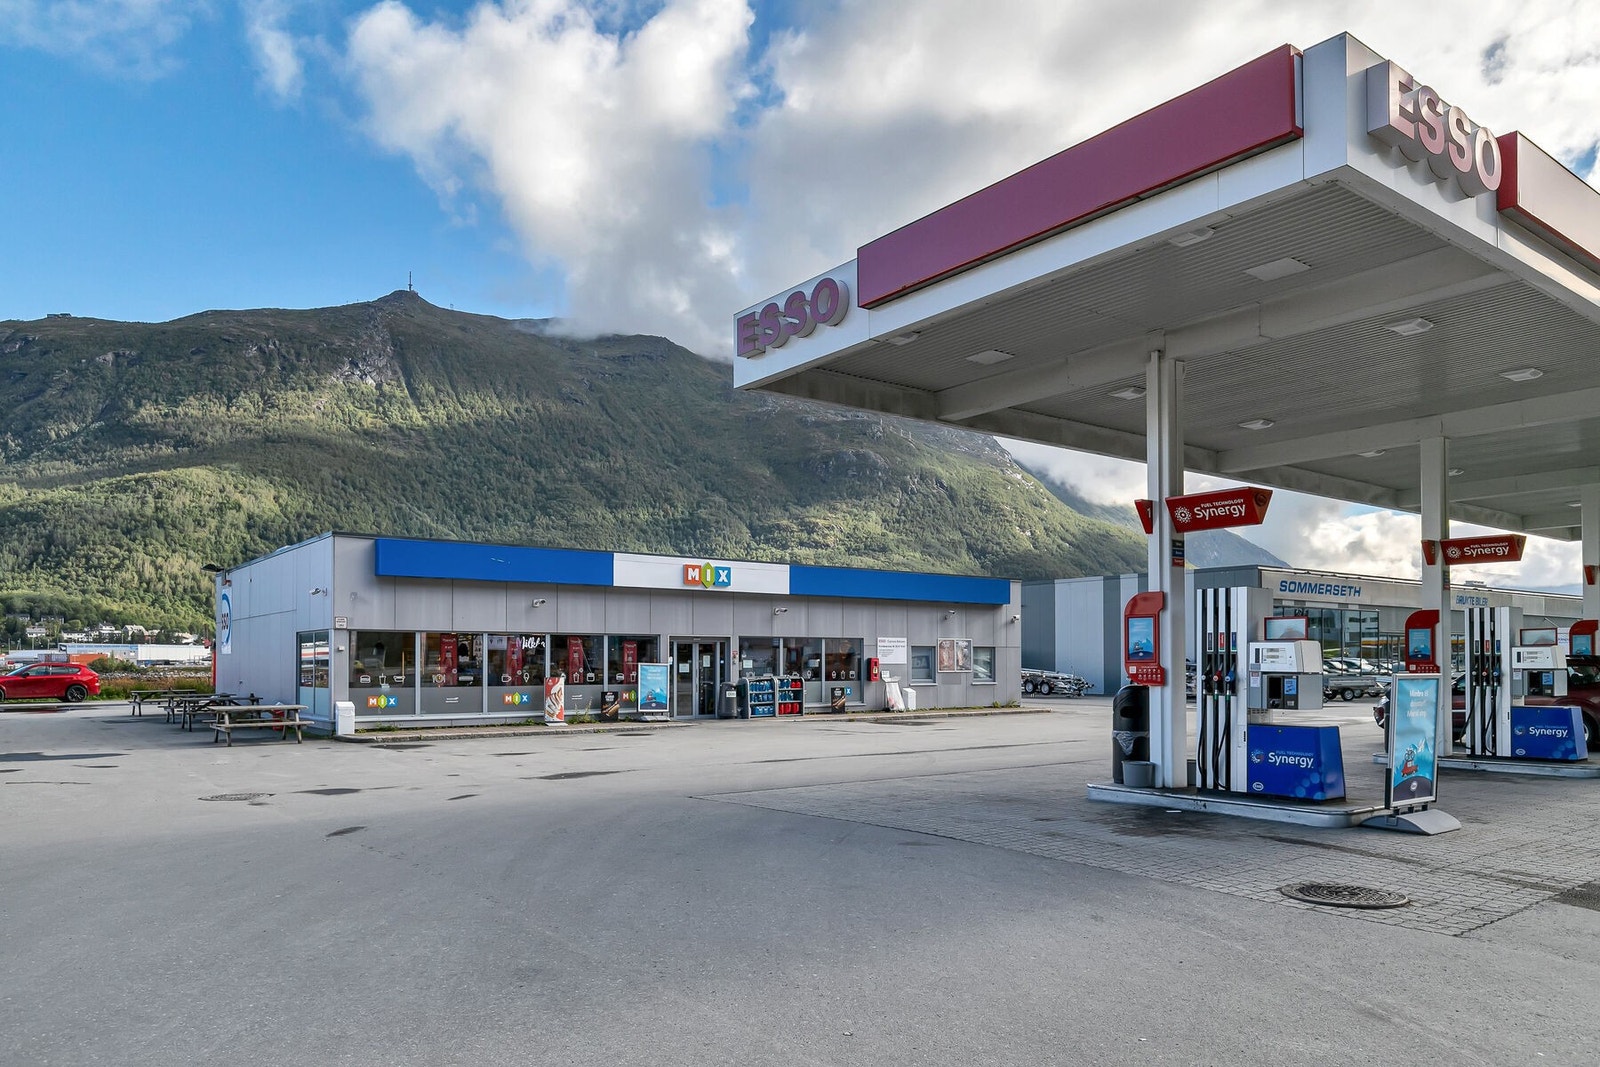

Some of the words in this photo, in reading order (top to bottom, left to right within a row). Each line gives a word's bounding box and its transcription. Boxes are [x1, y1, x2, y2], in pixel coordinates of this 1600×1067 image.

[1388, 60, 1502, 191] ESSO
[737, 277, 841, 358] ESSO
[1213, 499, 1244, 507] TECHNOLOGY
[1194, 504, 1246, 520] Synergy
[1463, 546, 1509, 557] Synergy
[686, 566, 729, 585] MIX
[1280, 580, 1362, 597] SOMMERSETH
[369, 696, 396, 706] MIX
[505, 694, 529, 704] MIX
[1529, 726, 1568, 738] Synergy
[1268, 752, 1314, 768] Synergy
